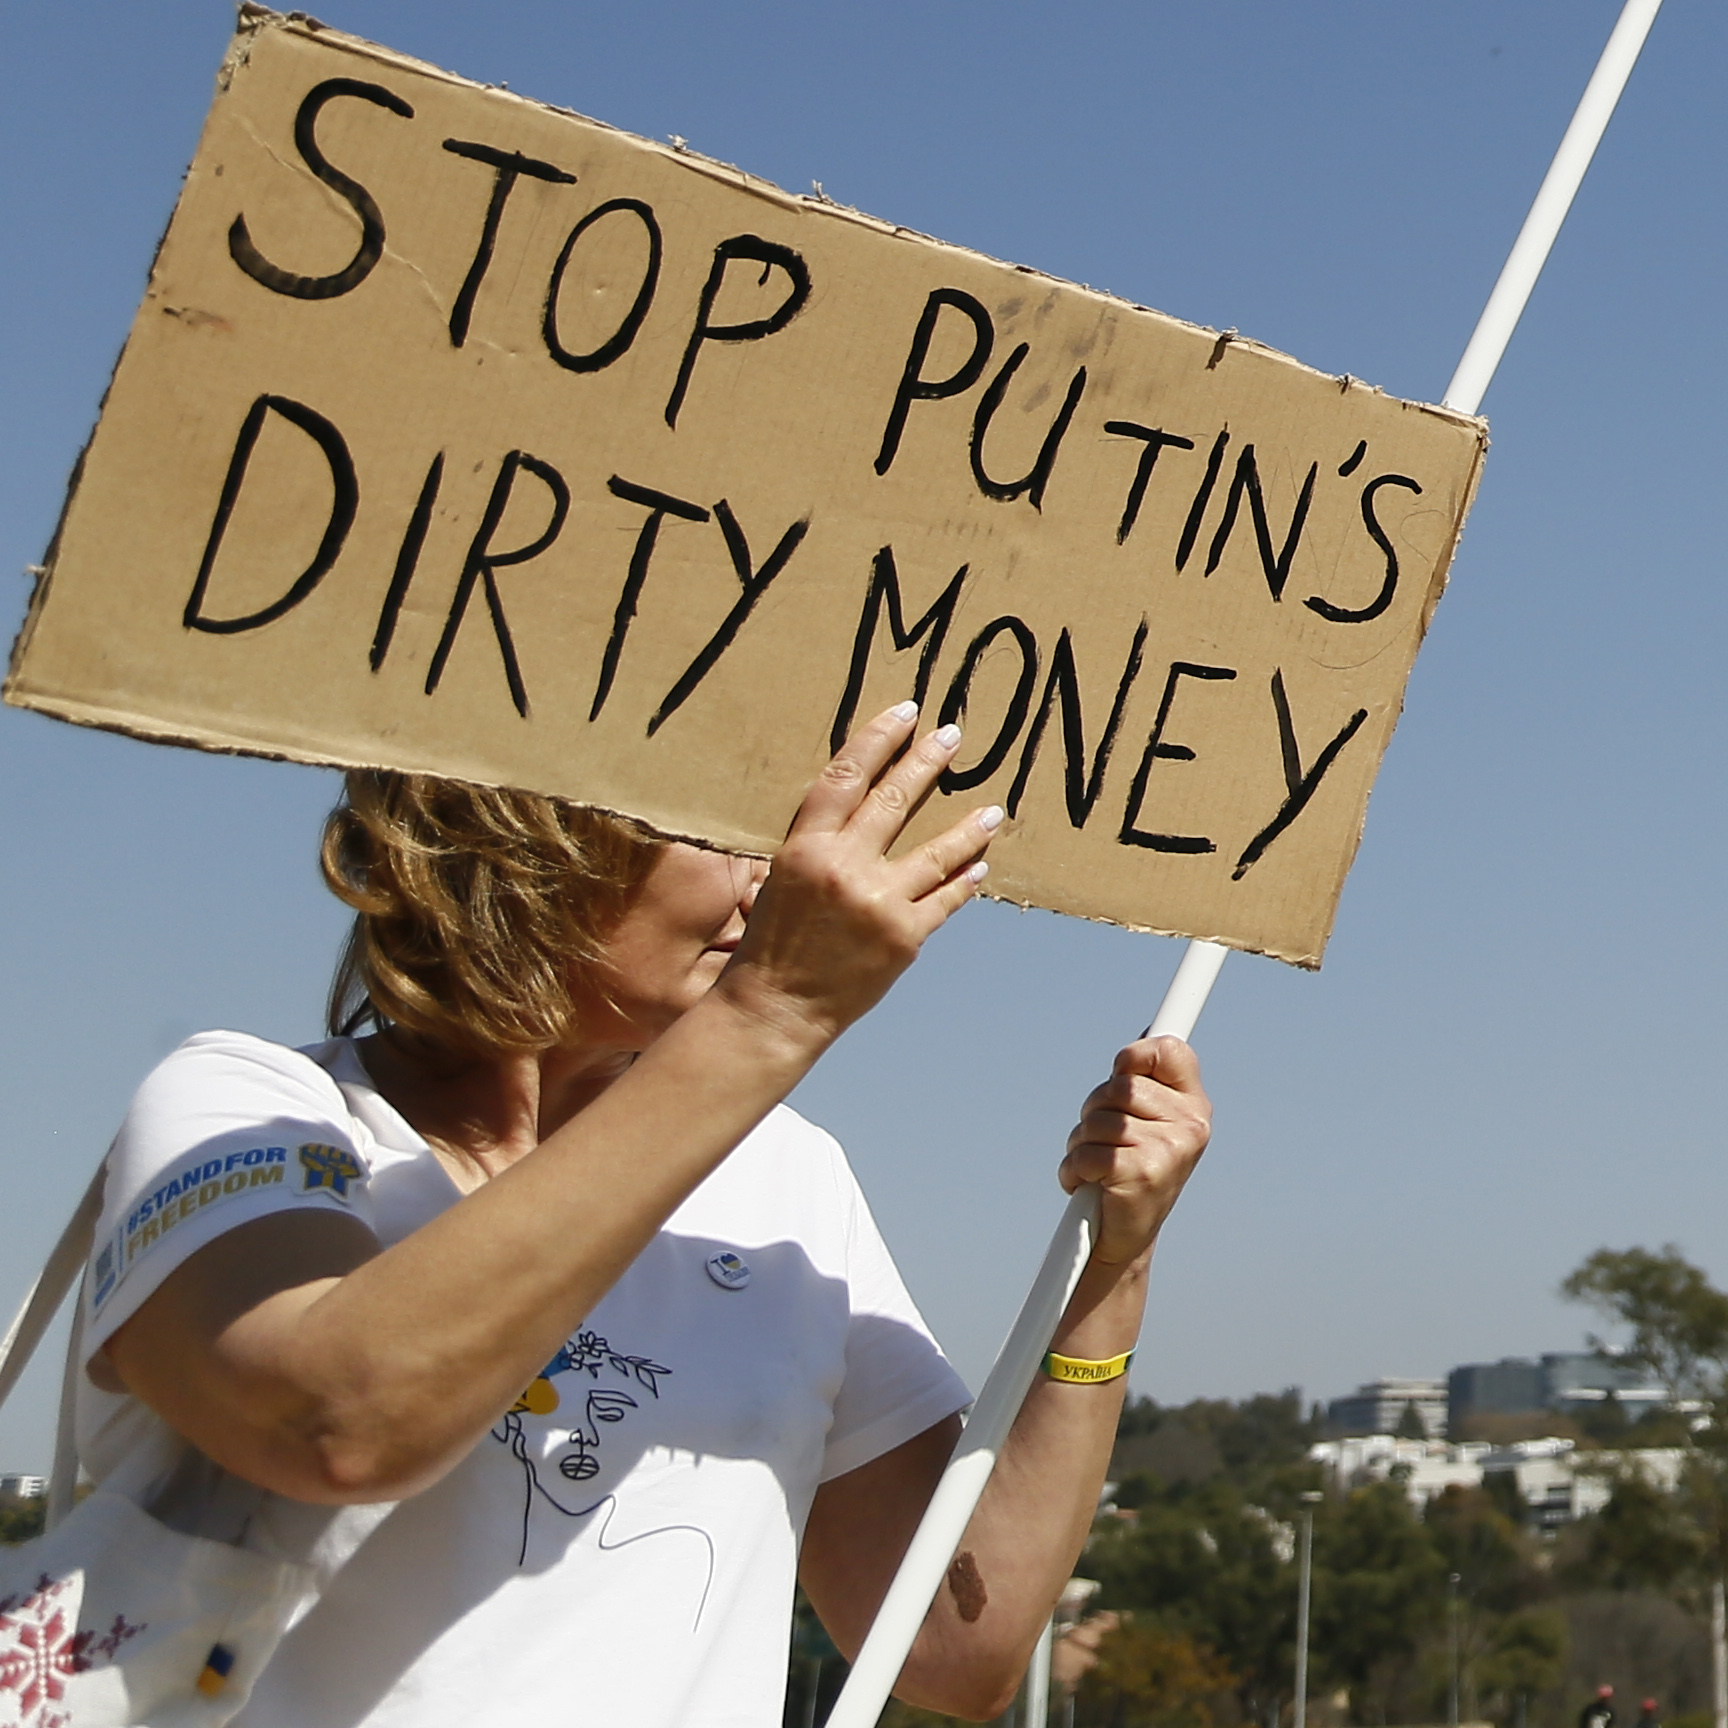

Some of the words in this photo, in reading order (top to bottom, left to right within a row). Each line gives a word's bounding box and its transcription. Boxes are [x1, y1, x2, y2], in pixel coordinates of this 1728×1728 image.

[228, 76, 813, 430] STOP
[874, 287, 1424, 625] PUTIN'S
[183, 392, 811, 738] DIRTY
[829, 546, 1369, 881] MONEY
[127, 1163, 286, 1262] FREEDOM
